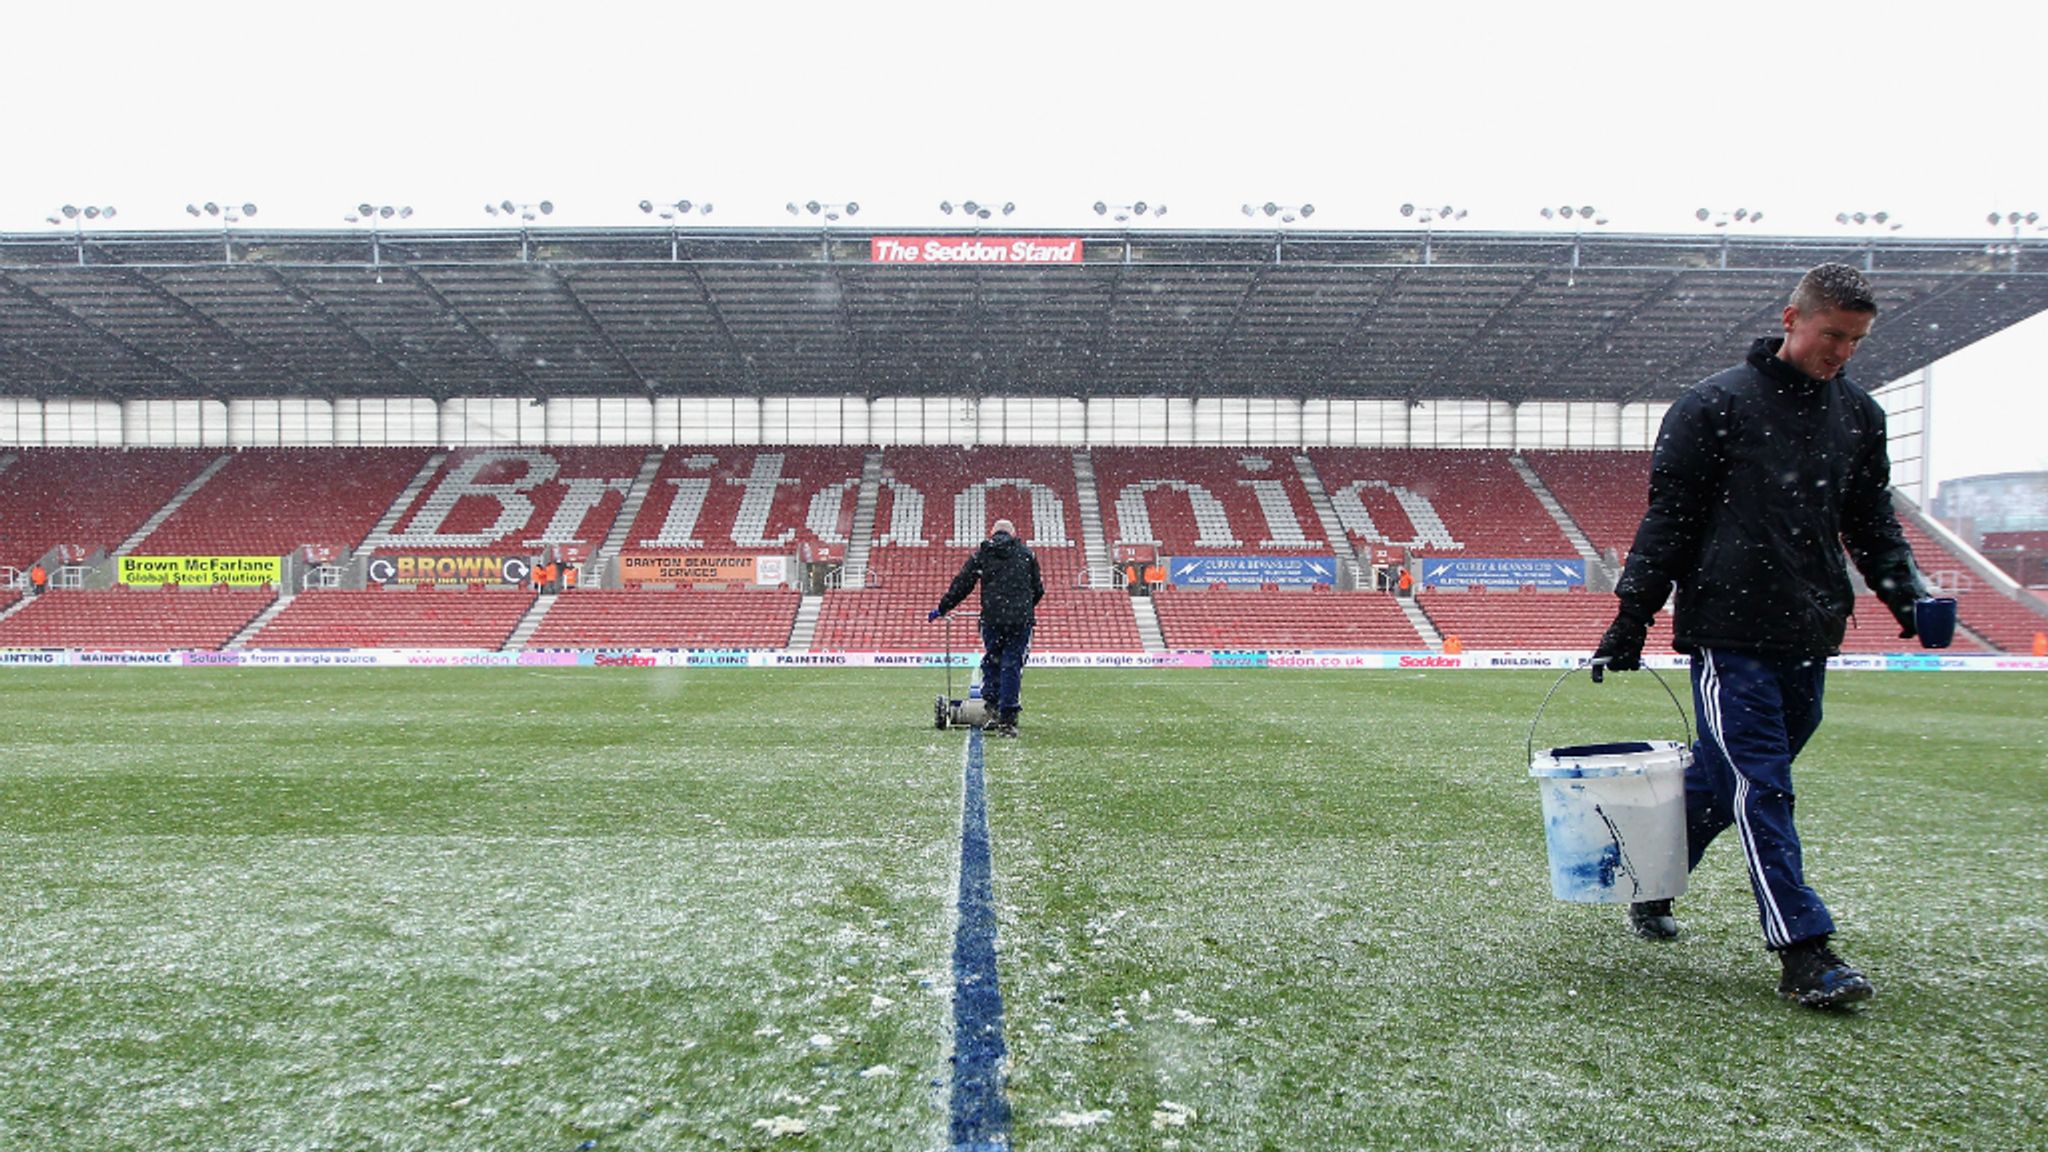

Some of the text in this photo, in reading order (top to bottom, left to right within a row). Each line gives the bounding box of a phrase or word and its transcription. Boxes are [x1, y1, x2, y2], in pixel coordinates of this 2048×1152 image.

[876, 241, 1076, 262] The Seddon Stand
[383, 449, 1465, 549] Britannia
[125, 558, 273, 571] Brown McFarlane
[397, 557, 502, 578] BROWN
[626, 558, 752, 568] DRAYTON BEAUMONT
[126, 572, 273, 583] Global Steel Solutions
[660, 568, 718, 577] SERVICES
[0, 654, 54, 663] INTING
[81, 654, 172, 663] MAINTENANCE
[189, 654, 247, 663] Solutions
[251, 654, 280, 663] from
[294, 654, 331, 665] single
[594, 654, 656, 667] Seddon
[687, 656, 749, 664] BUILDING
[777, 656, 846, 664] PAINTING
[1051, 655, 1080, 664] from
[1084, 656, 1092, 664] a
[1096, 655, 1133, 666] single
[1399, 656, 1461, 668] Seddon
[1491, 658, 1552, 666] BUILDING
